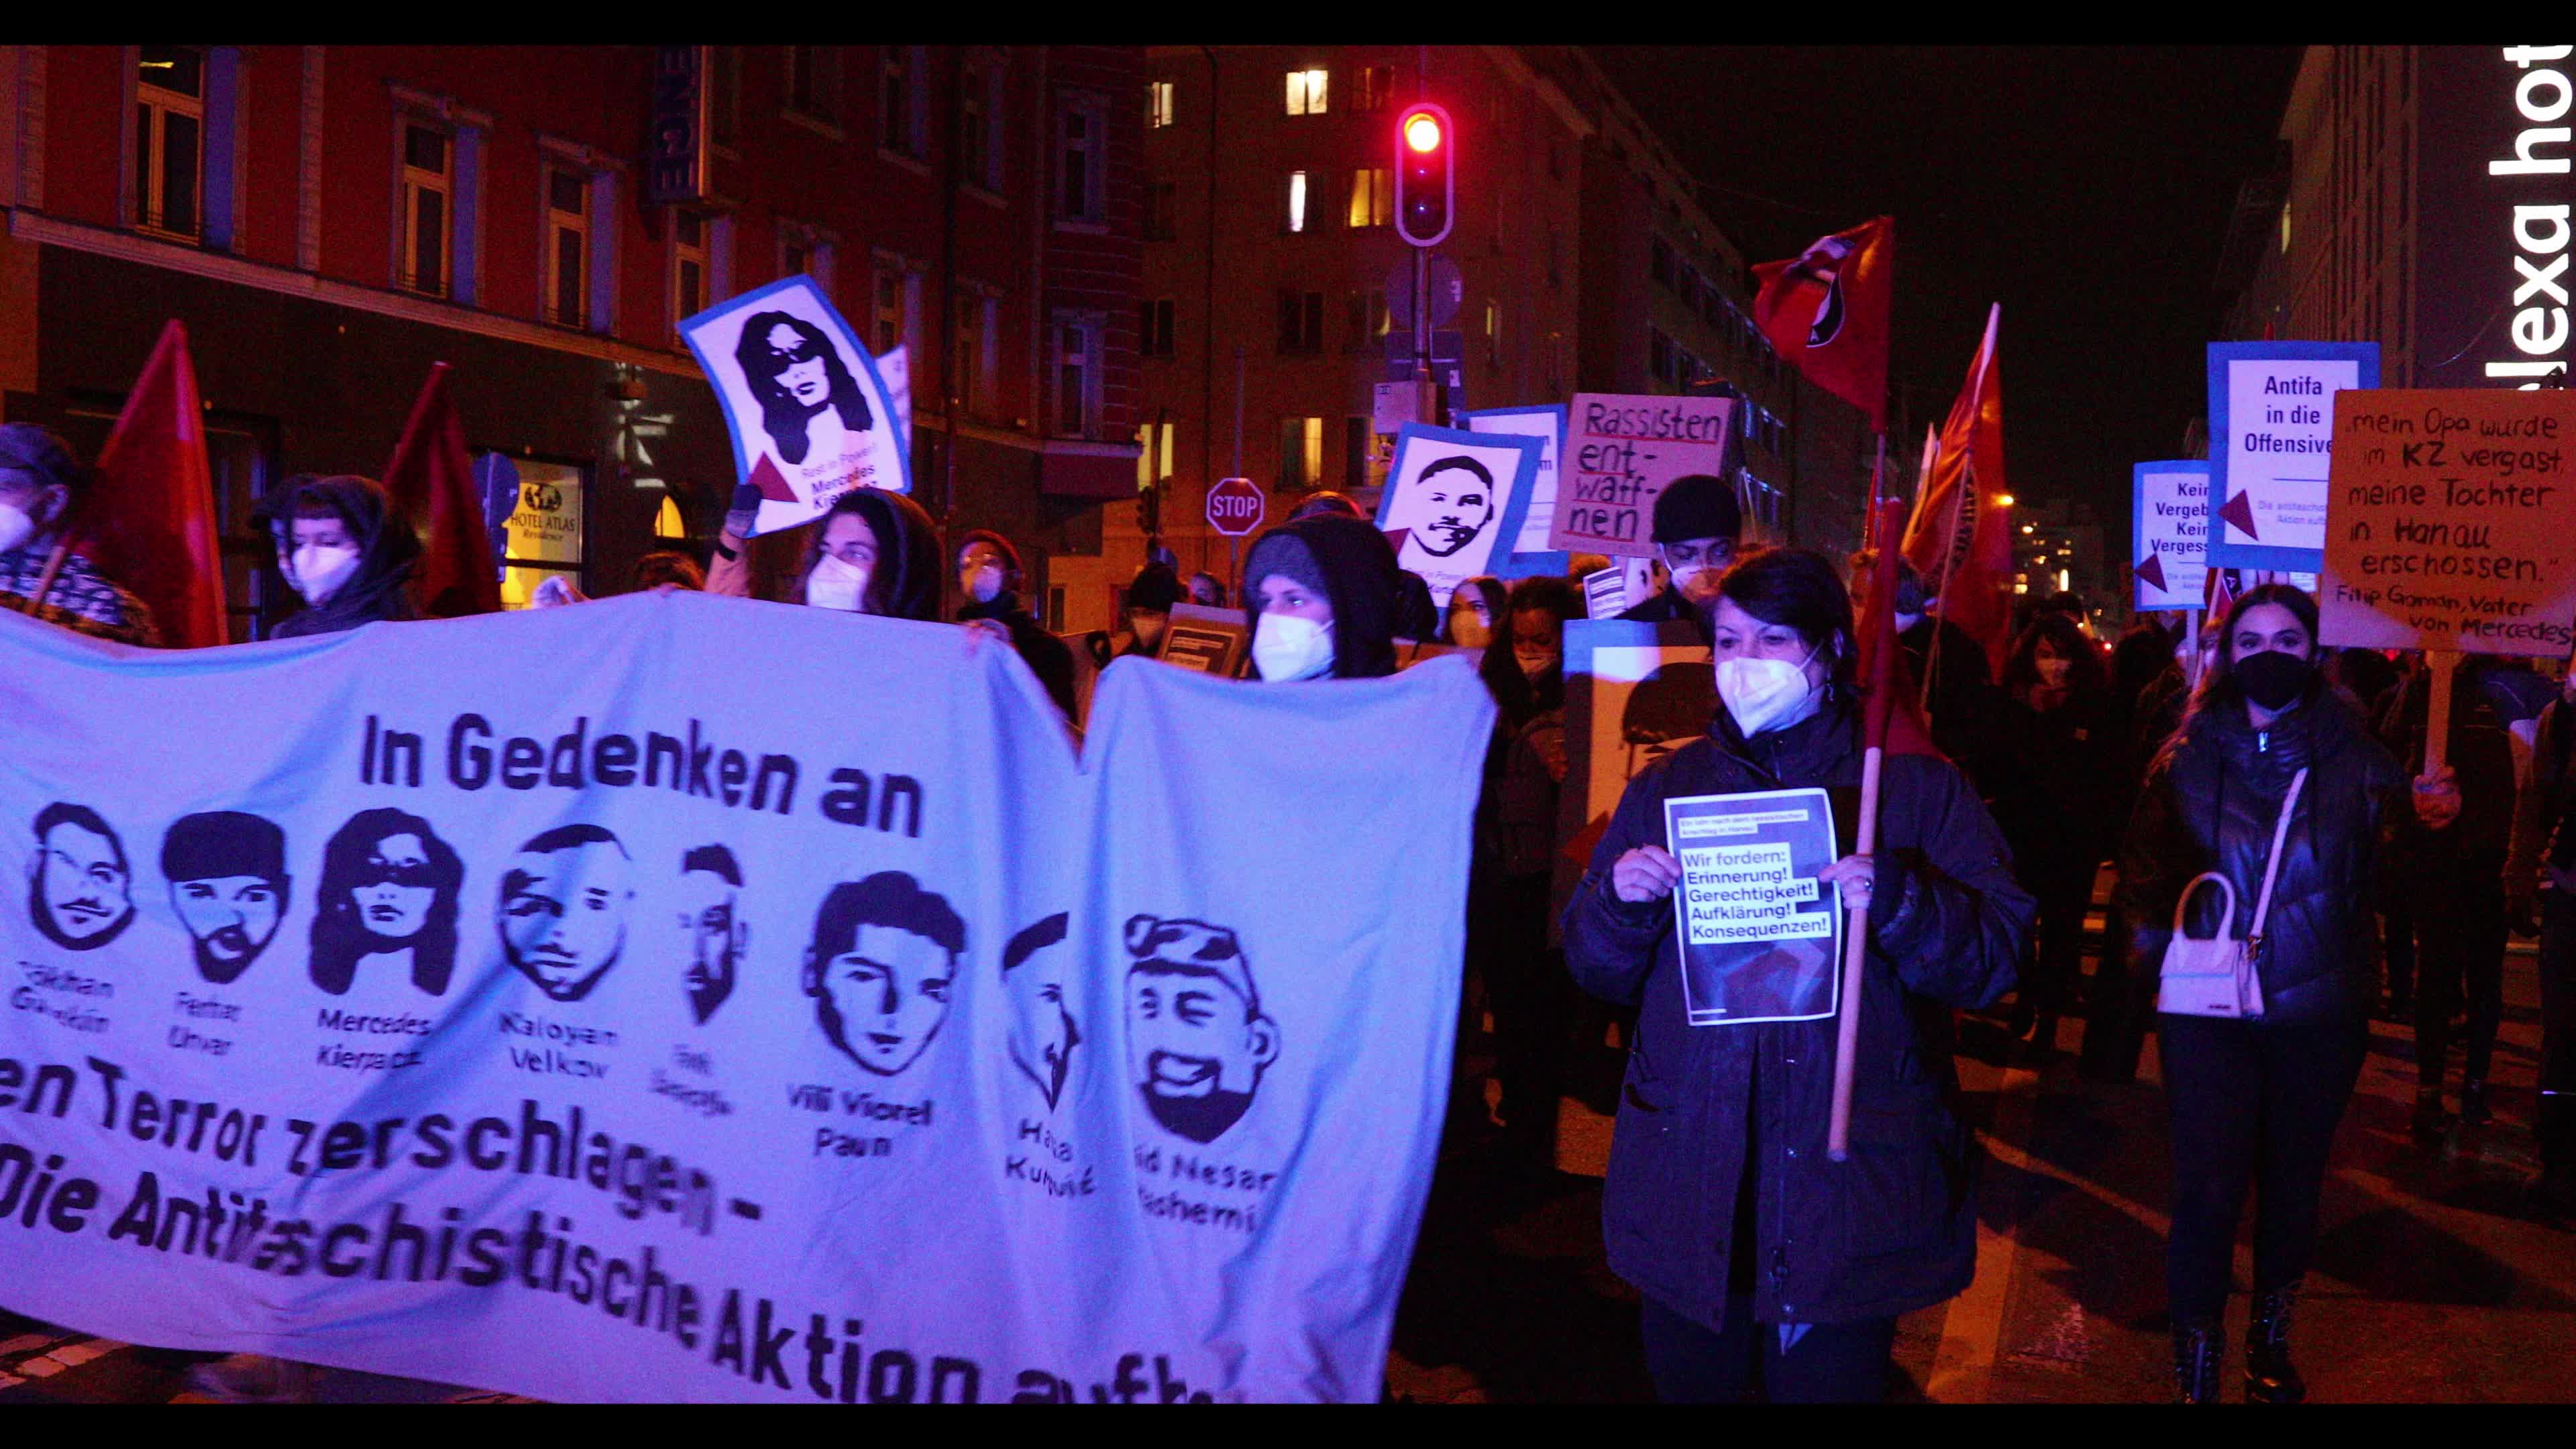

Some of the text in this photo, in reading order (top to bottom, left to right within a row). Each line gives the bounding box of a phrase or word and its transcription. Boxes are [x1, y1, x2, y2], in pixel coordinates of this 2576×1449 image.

[2485, 205, 2571, 390] lexa
[2265, 376, 2322, 394] Antifa
[1586, 403, 1721, 440] Rassisten
[2267, 405, 2320, 424] in die
[2425, 407, 2470, 439] Opa
[2479, 414, 2558, 438] wurde
[2245, 433, 2332, 453] Offensive
[2363, 447, 2385, 466] im
[2403, 441, 2448, 468] KZ
[812, 465, 875, 495] Mercedes
[2349, 478, 2555, 507] meine Tochter
[1212, 495, 1258, 518] STOP
[511, 513, 576, 531] HOTEL ATLAS
[1569, 508, 1638, 537] nen
[2350, 516, 2491, 549] in Hanau
[2409, 616, 2572, 645] von Mercedes
[361, 712, 924, 838] In Gedenken an
[1683, 850, 1787, 868] Wir fordern:
[1687, 867, 1788, 885] Erinnerung!
[1689, 883, 1813, 904] Gerechtigkeit!
[1690, 903, 1791, 920] Aufklärung!
[1693, 918, 1827, 939] Konsequenzen!
[317, 1008, 433, 1036] Mercedes
[510, 1047, 611, 1079] Velkov
[86, 1055, 268, 1167] Terror
[1172, 1154, 1278, 1191] Nesar
[0, 1142, 103, 1234] Die
[711, 1288, 982, 1403] Aktion
